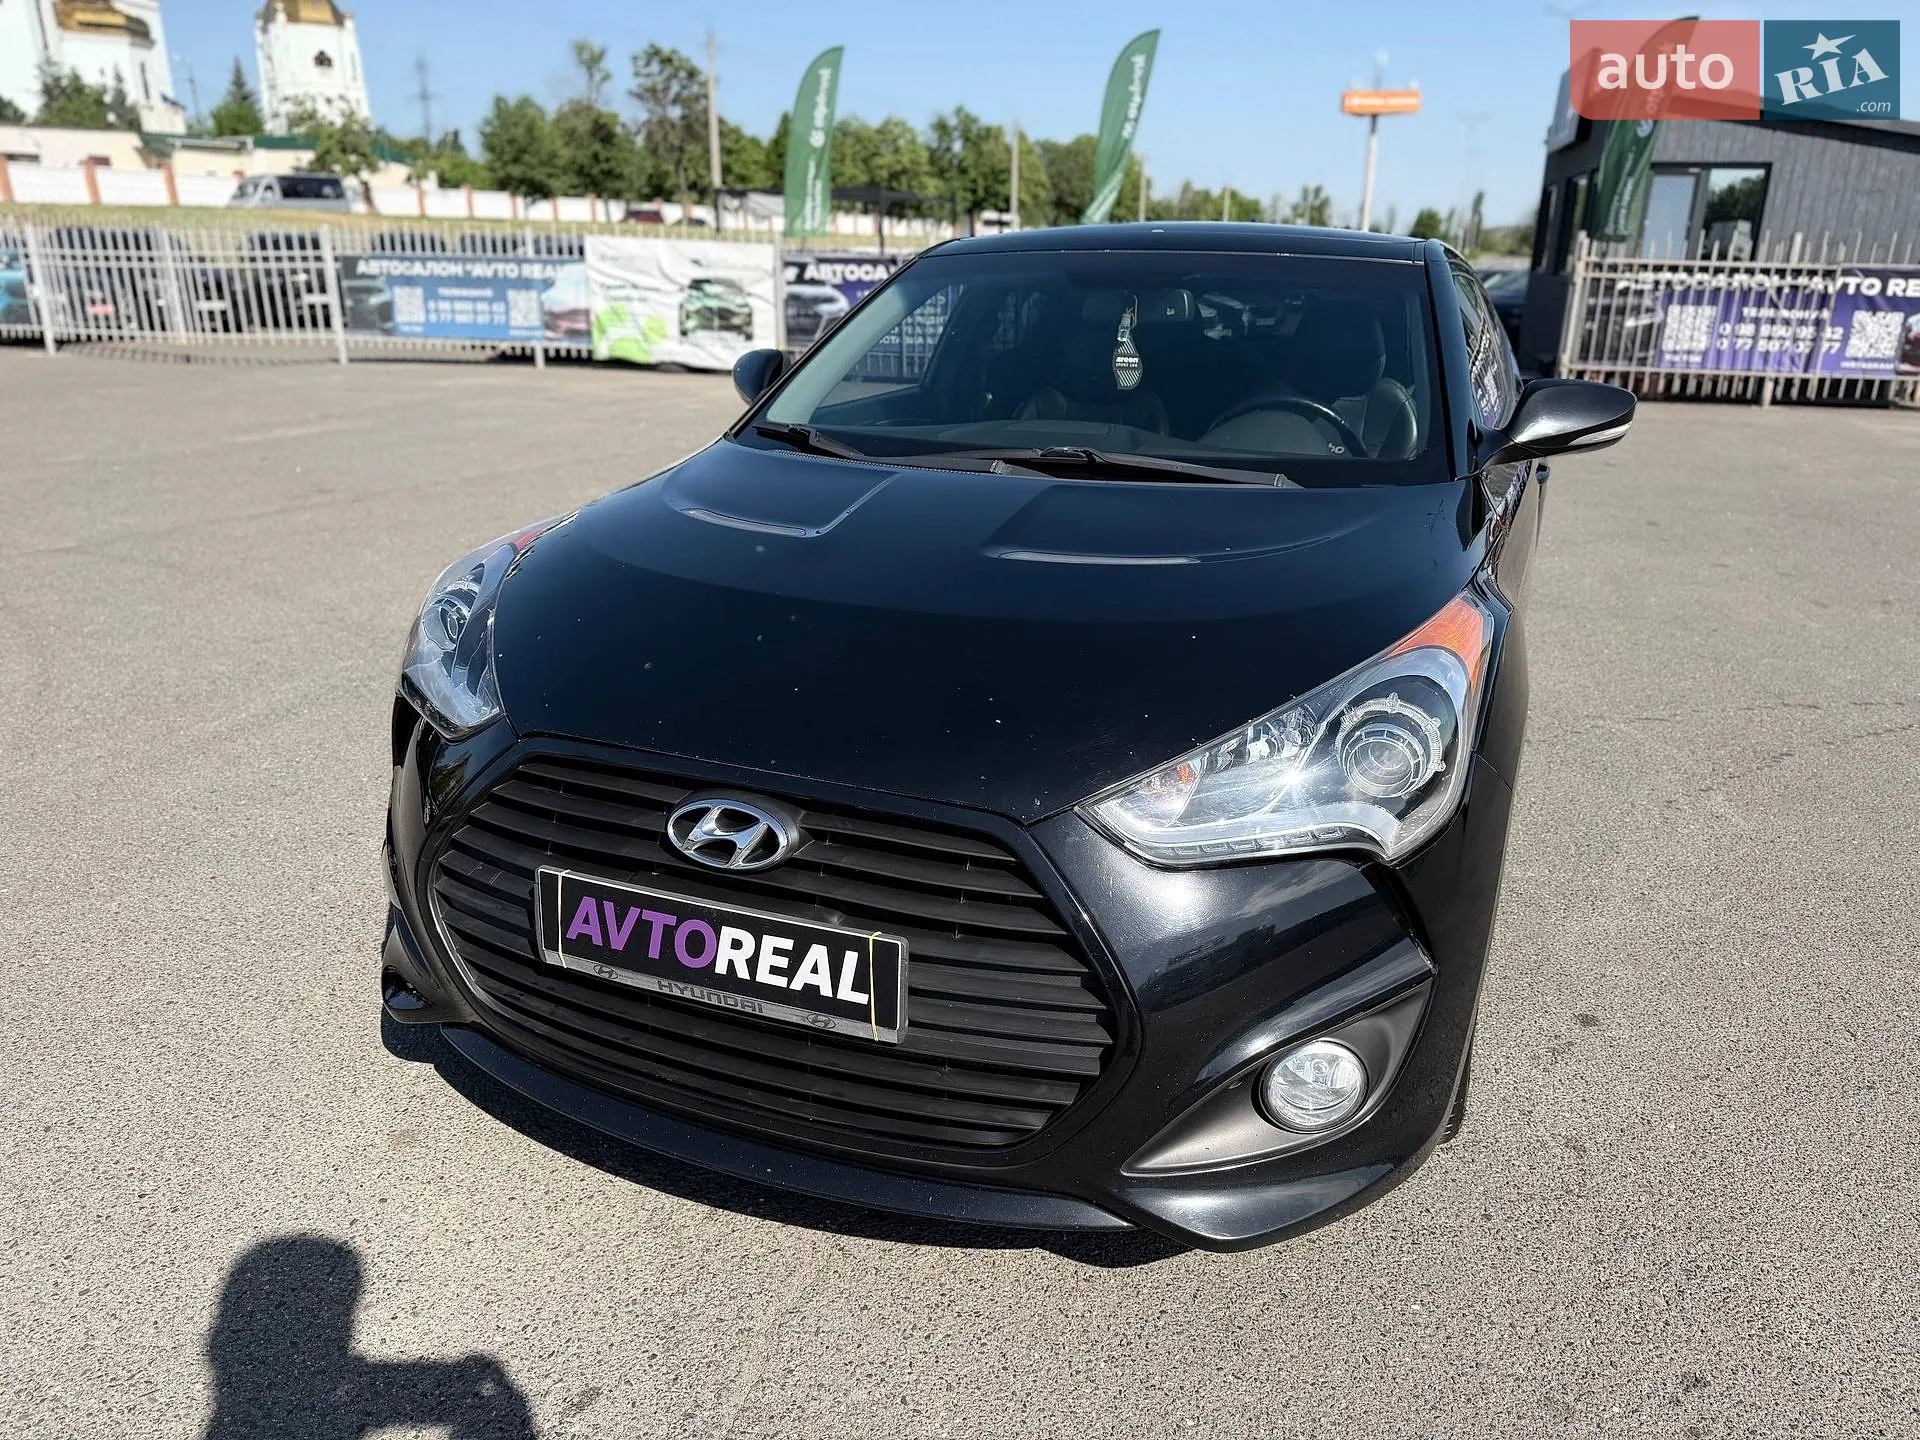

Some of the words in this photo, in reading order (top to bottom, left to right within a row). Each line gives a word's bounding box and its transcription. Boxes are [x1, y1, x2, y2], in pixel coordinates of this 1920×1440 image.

[356, 259, 464, 277] АВТОСАЛОН
[803, 262, 895, 283] АВТОСА
[566, 896, 869, 1005] AVTOREAL
[657, 979, 764, 1014] HYUNDAI
